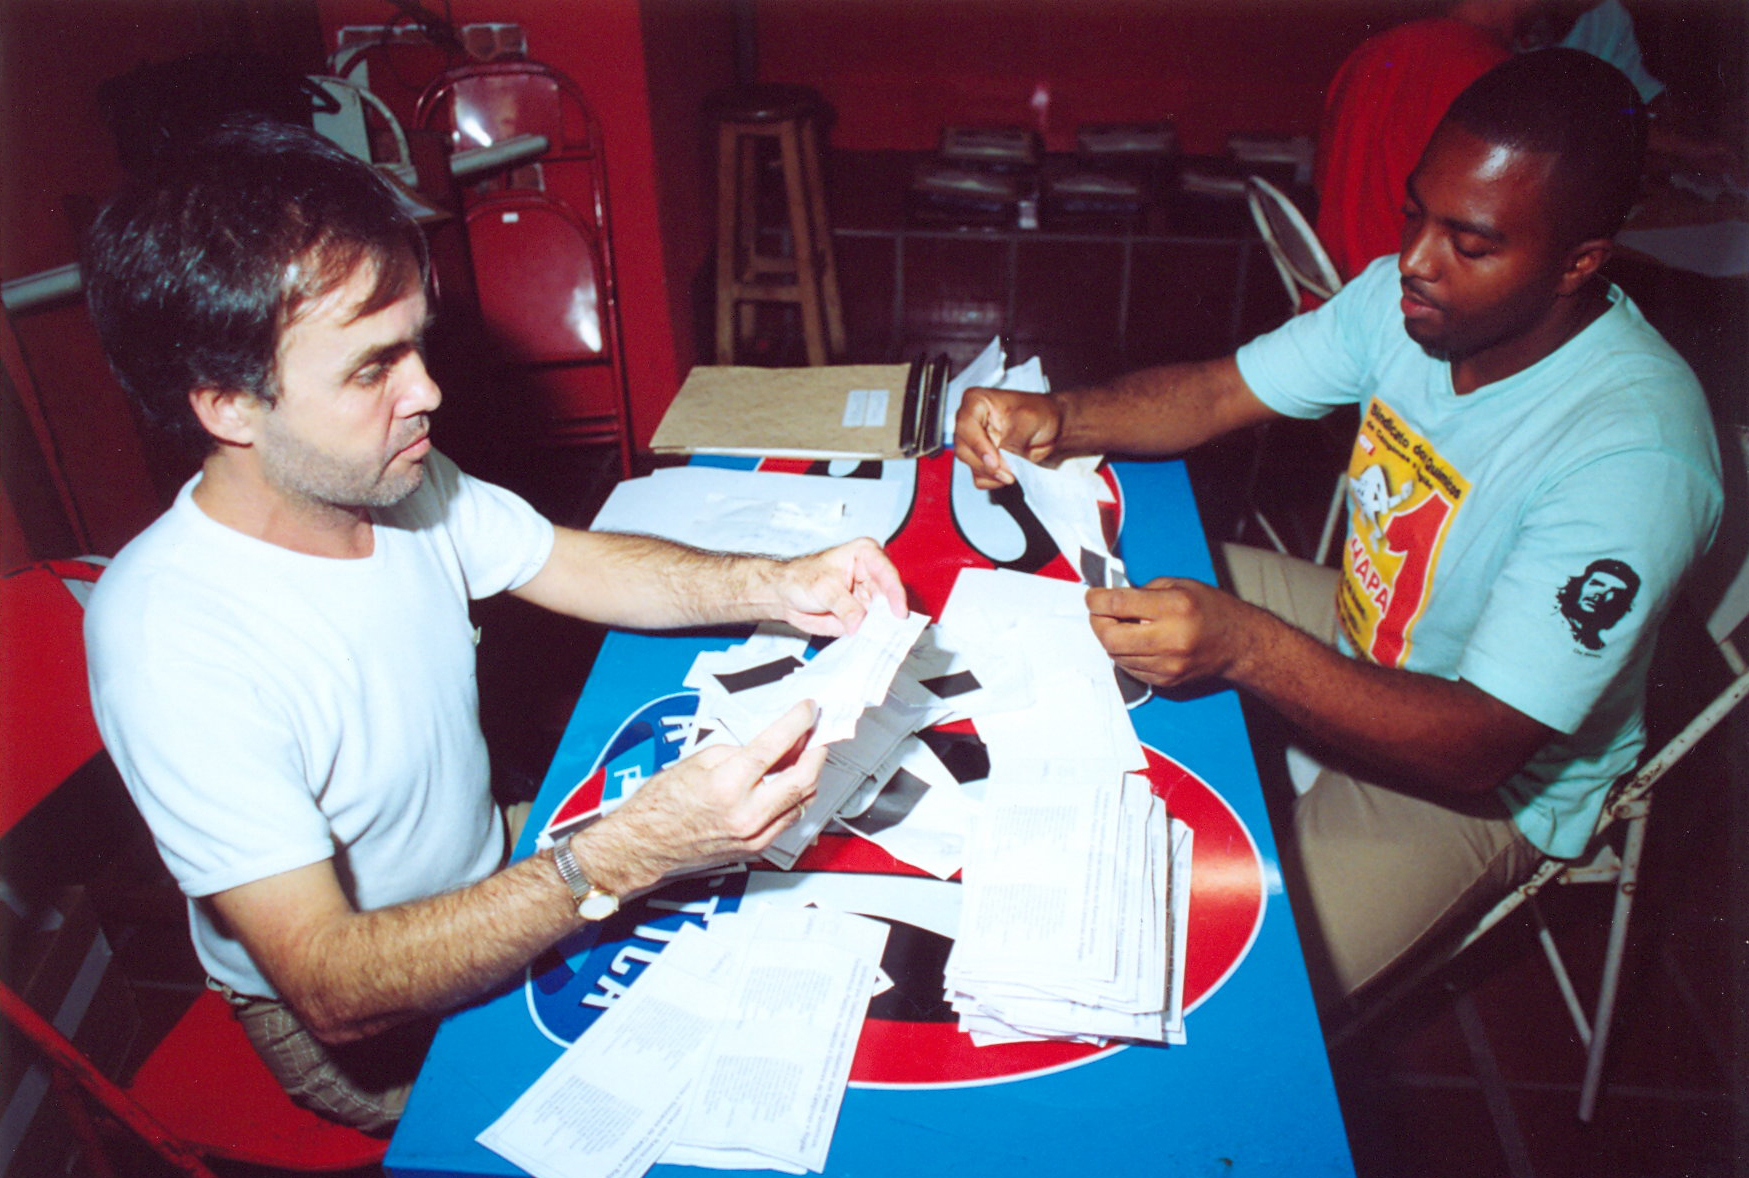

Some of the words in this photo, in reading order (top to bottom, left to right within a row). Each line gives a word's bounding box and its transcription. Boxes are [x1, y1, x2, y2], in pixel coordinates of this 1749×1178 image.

[1371, 403, 1409, 448] Sindicato
[1350, 536, 1392, 613] HAPA
[1370, 488, 1453, 669] 1
